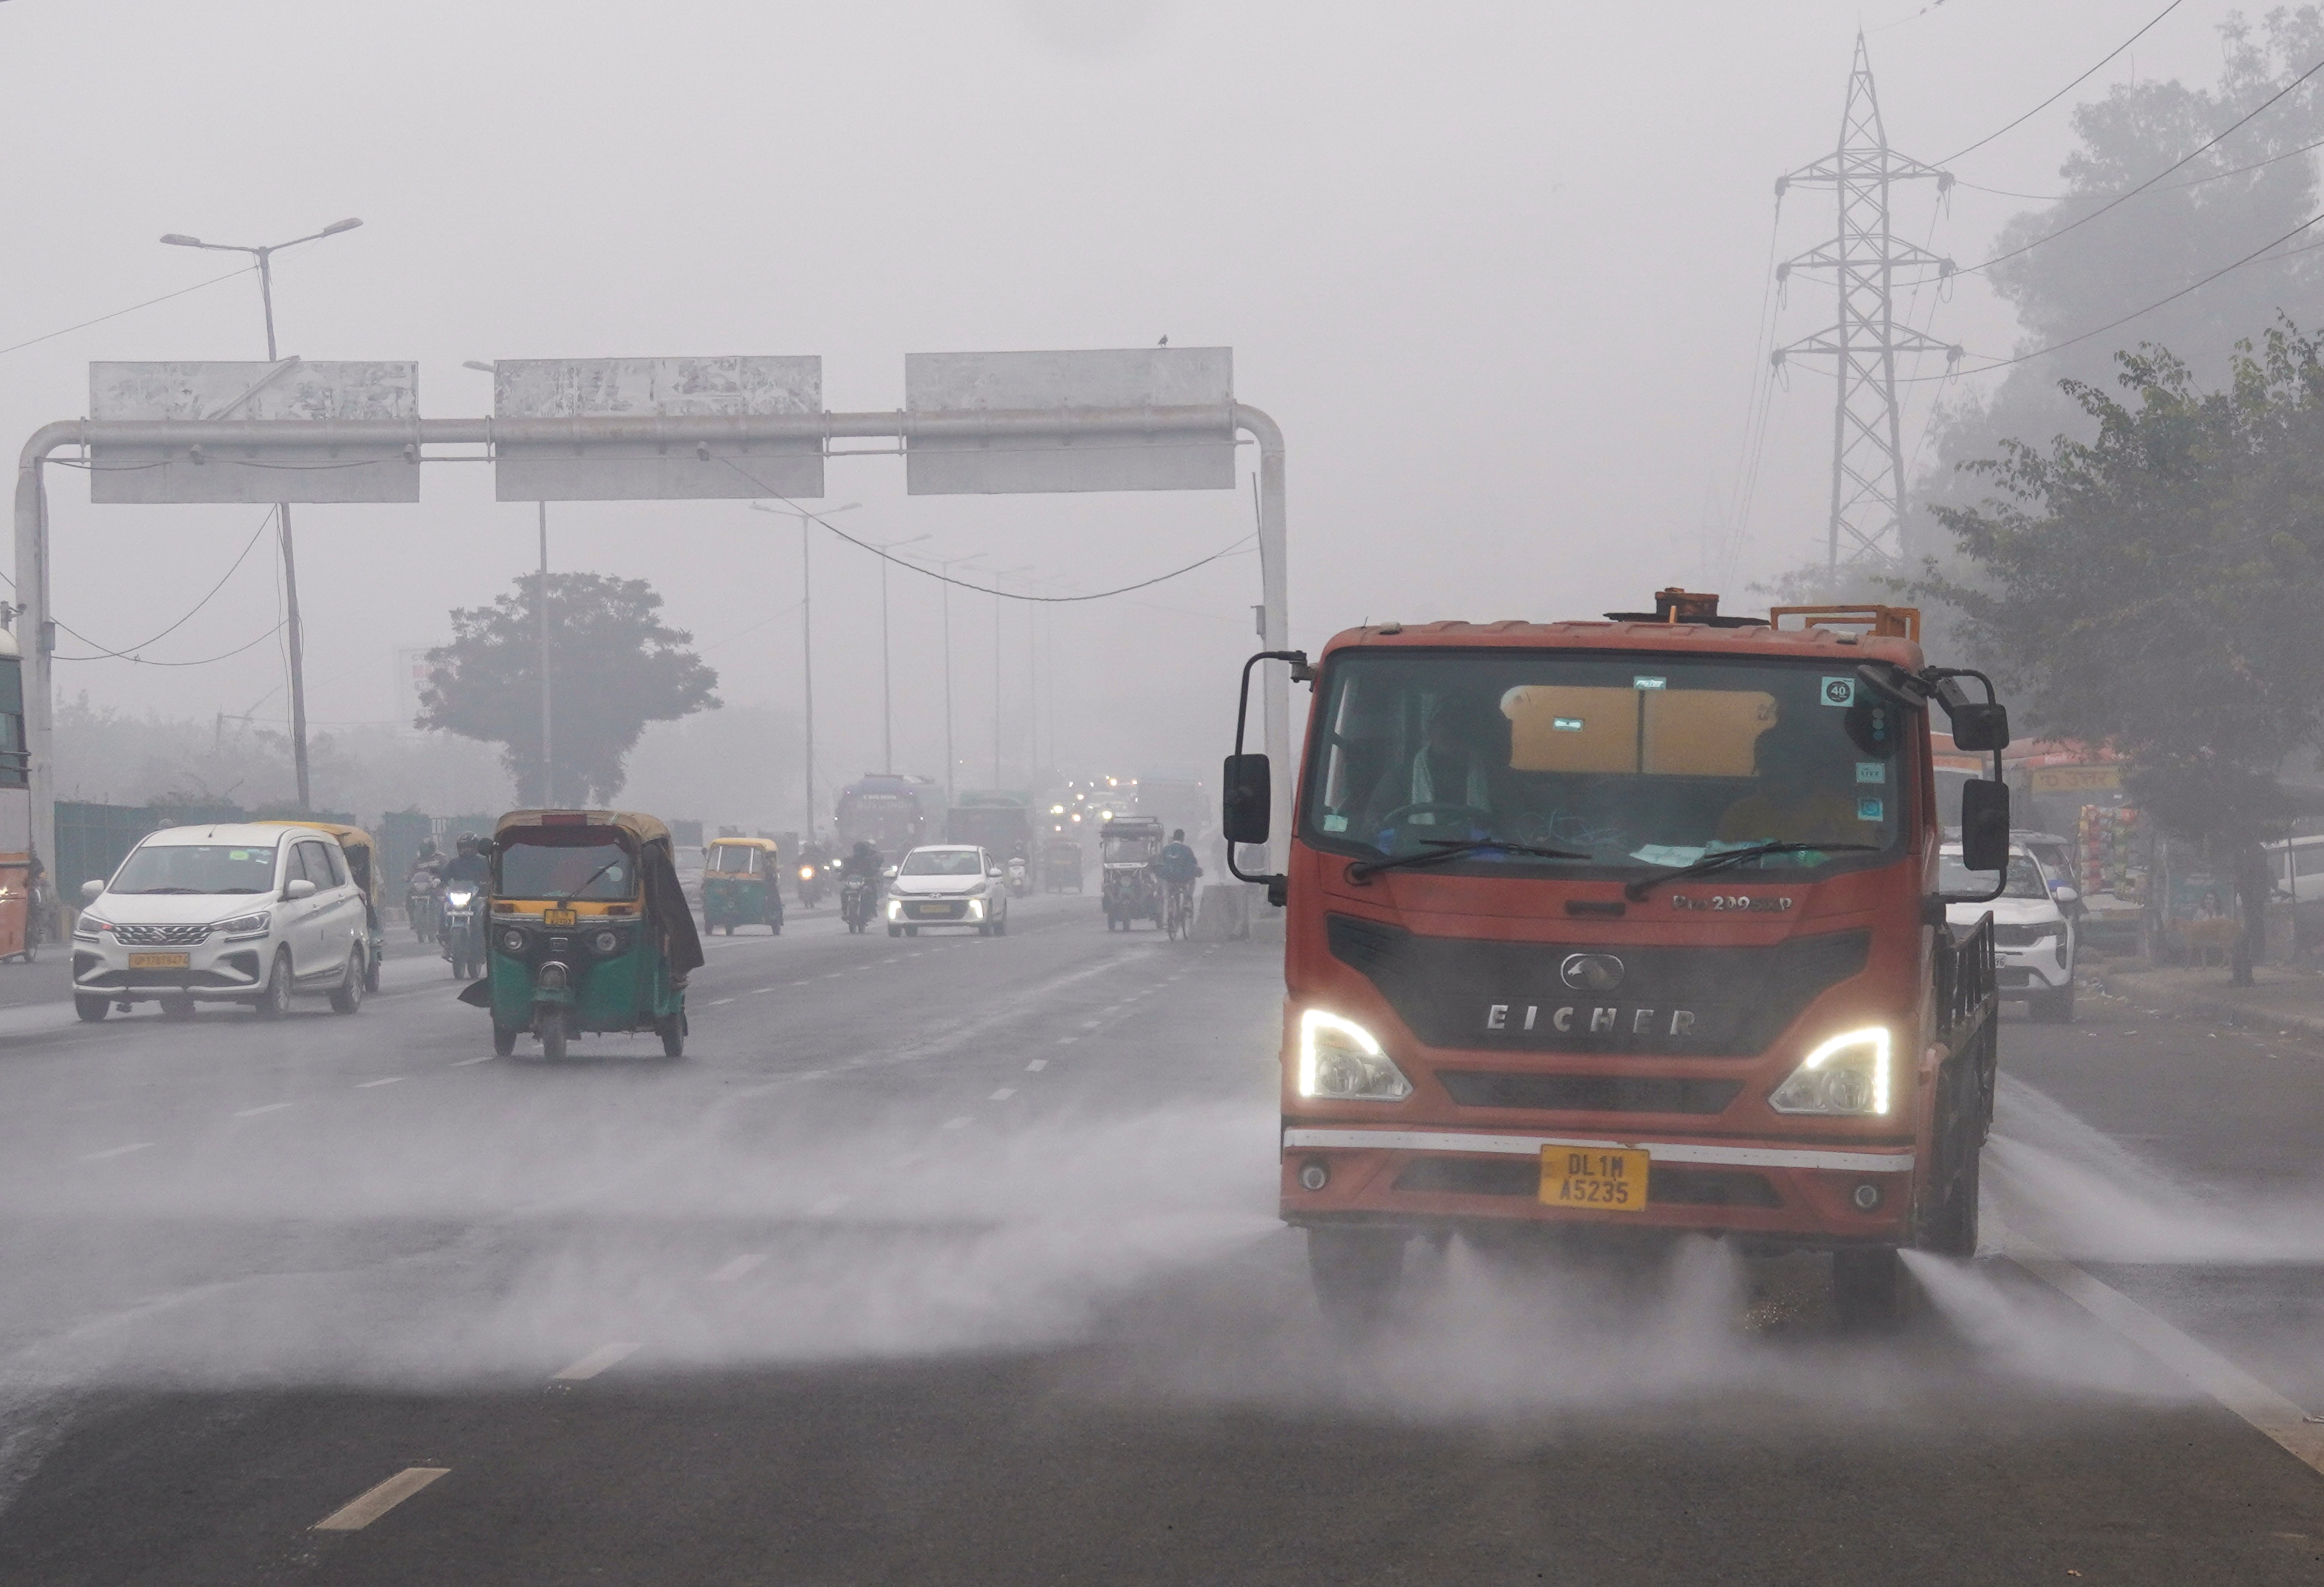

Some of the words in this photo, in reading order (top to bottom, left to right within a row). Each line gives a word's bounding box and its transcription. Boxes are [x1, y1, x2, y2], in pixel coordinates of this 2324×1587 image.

[1831, 686, 1846, 695] 40
[1486, 1004, 1696, 1036] EICHER
[1569, 1153, 1623, 1177] DL1M
[1560, 1178, 1628, 1204] A5235
